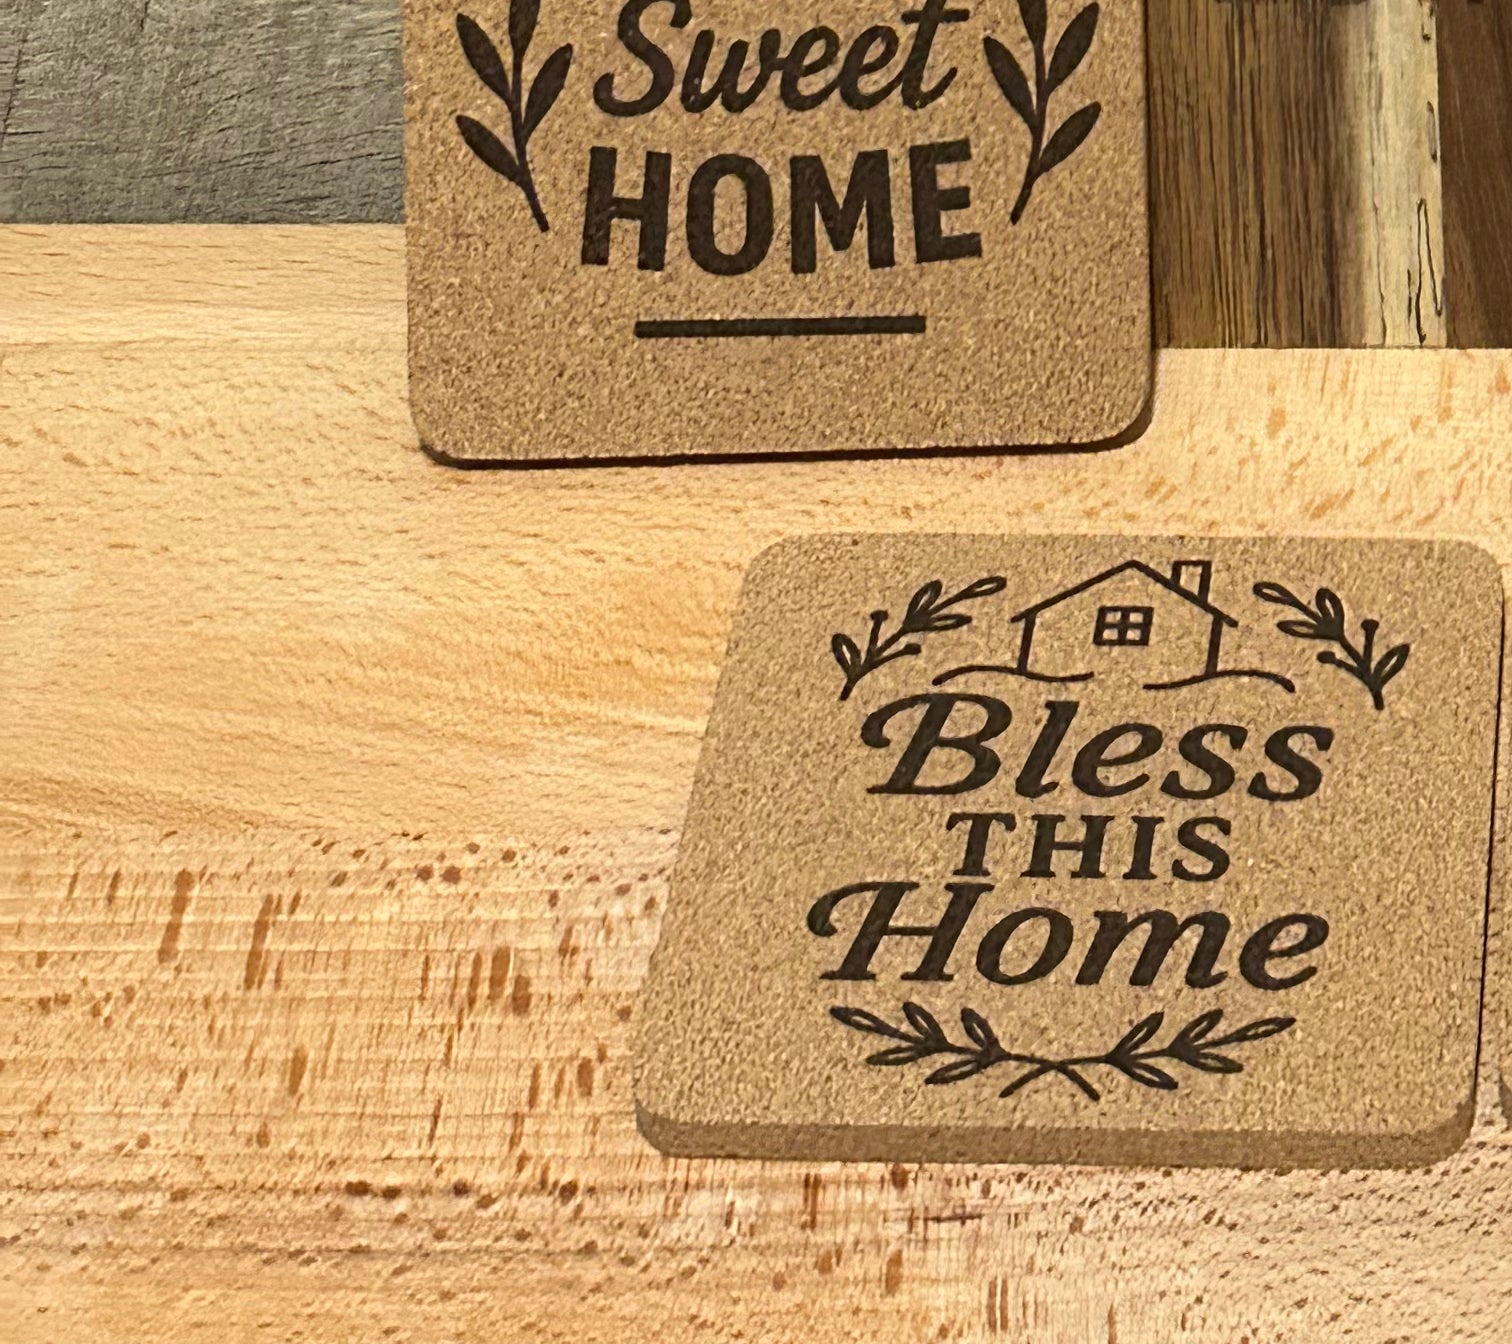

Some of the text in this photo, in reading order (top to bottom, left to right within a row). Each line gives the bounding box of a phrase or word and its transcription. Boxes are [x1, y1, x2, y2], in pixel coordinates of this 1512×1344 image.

[581, 138, 982, 276] HOME
[860, 692, 1335, 802] Bless
[946, 812, 1232, 883] THIS
[806, 881, 1330, 991] Home
